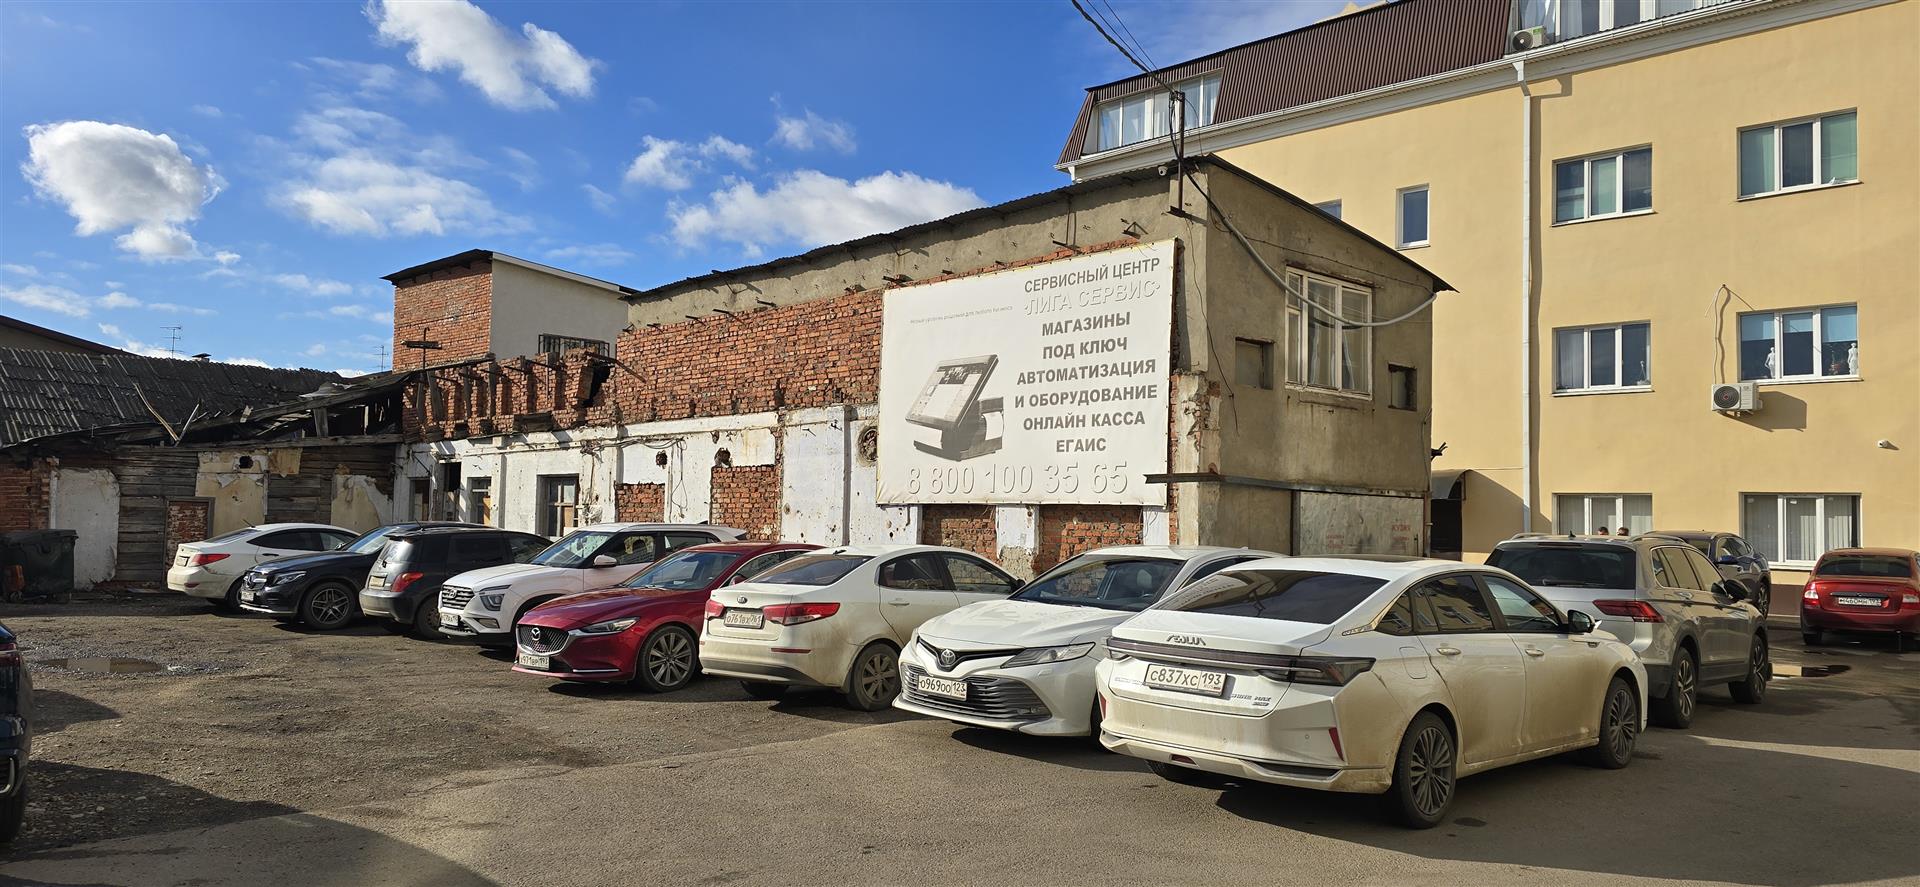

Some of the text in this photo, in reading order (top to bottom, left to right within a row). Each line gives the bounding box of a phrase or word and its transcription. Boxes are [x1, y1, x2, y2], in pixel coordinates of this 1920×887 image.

[1024, 257, 1160, 293] СЕРВИСНЫЙ ЦЕНТР
[1041, 311, 1131, 337] МАГАЗИНЫ
[1042, 336, 1128, 360] ПОД КЛЮЧ
[1016, 359, 1156, 386] АВТОМАТИЗАЦИЯ
[1014, 384, 1158, 409] И ОБОРУДОВАНИЕ
[1023, 410, 1146, 431] ОНЛАЙН КАССА
[1055, 437, 1107, 453] ЕГАИС
[908, 460, 1129, 495] 8 800 100 35 65
